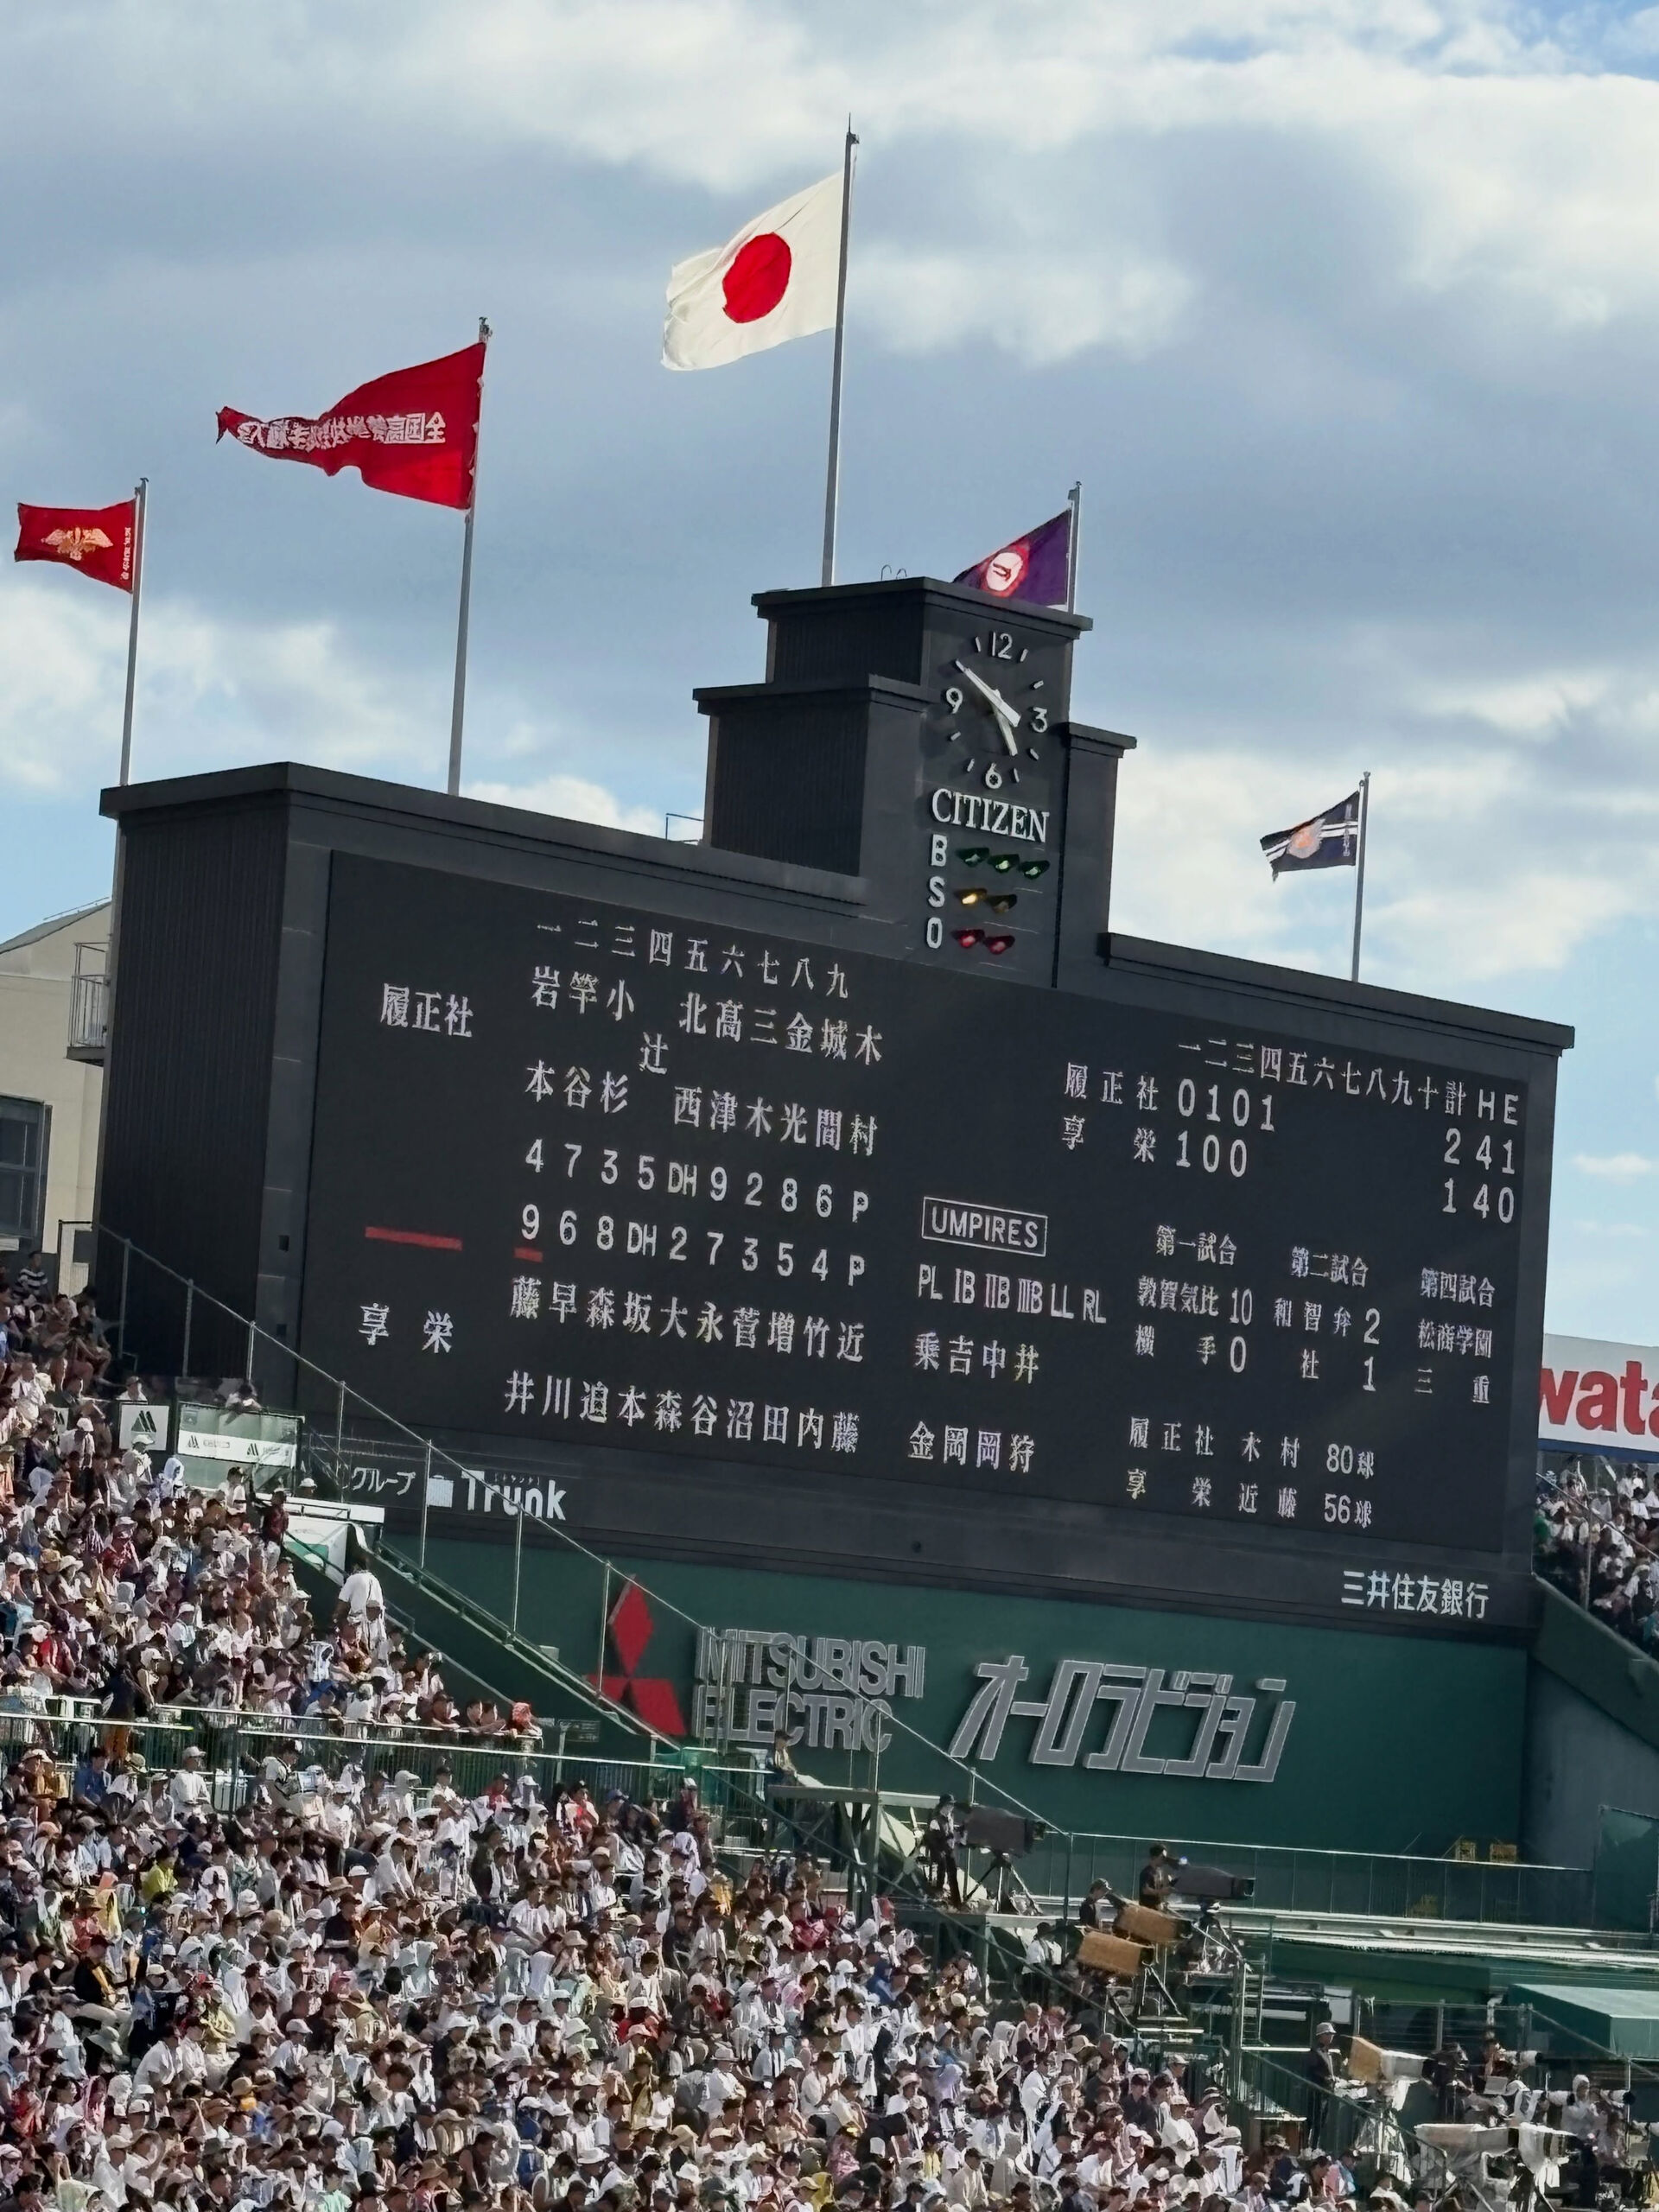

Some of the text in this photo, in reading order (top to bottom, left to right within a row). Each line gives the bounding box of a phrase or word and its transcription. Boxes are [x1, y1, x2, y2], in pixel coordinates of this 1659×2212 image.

[991, 631, 1012, 660] 12
[946, 688, 962, 714] 9
[1031, 707, 1047, 733] 3
[985, 762, 1002, 789] 6
[931, 788, 1050, 843] CITIZEN
[931, 834, 948, 867] B
[928, 875, 945, 908] S
[380, 983, 474, 1037] 履正社
[525, 1139, 868, 1223] 4 7 3 5 DH 9 2 8 6 P
[522, 1204, 865, 1286] 9 6 8 DH 2 7 3 5 4 P
[931, 1205, 1039, 1249] UMPIRES
[1156, 1225, 1236, 1265] 第一試合
[1291, 1246, 1369, 1287] 第二試合
[918, 1264, 943, 1300] PL
[1051, 1283, 1074, 1319] LL
[1083, 1289, 1106, 1323] RL
[1137, 1275, 1252, 1325] 敦賀気比 10
[1421, 1268, 1495, 1307] 第四試合
[1363, 1308, 1380, 1344] 2
[1418, 1319, 1492, 1358] 松商学園
[1230, 1336, 1246, 1373] 0
[1363, 1357, 1376, 1391] 1
[461, 1470, 567, 1521] Trunk
[1341, 1569, 1489, 1619] 三井住友銀行
[696, 1625, 926, 1699] MITSUBISHI
[695, 1681, 893, 1752] ELECTRIC
[950, 1654, 1296, 1783] オーロラビジョン
